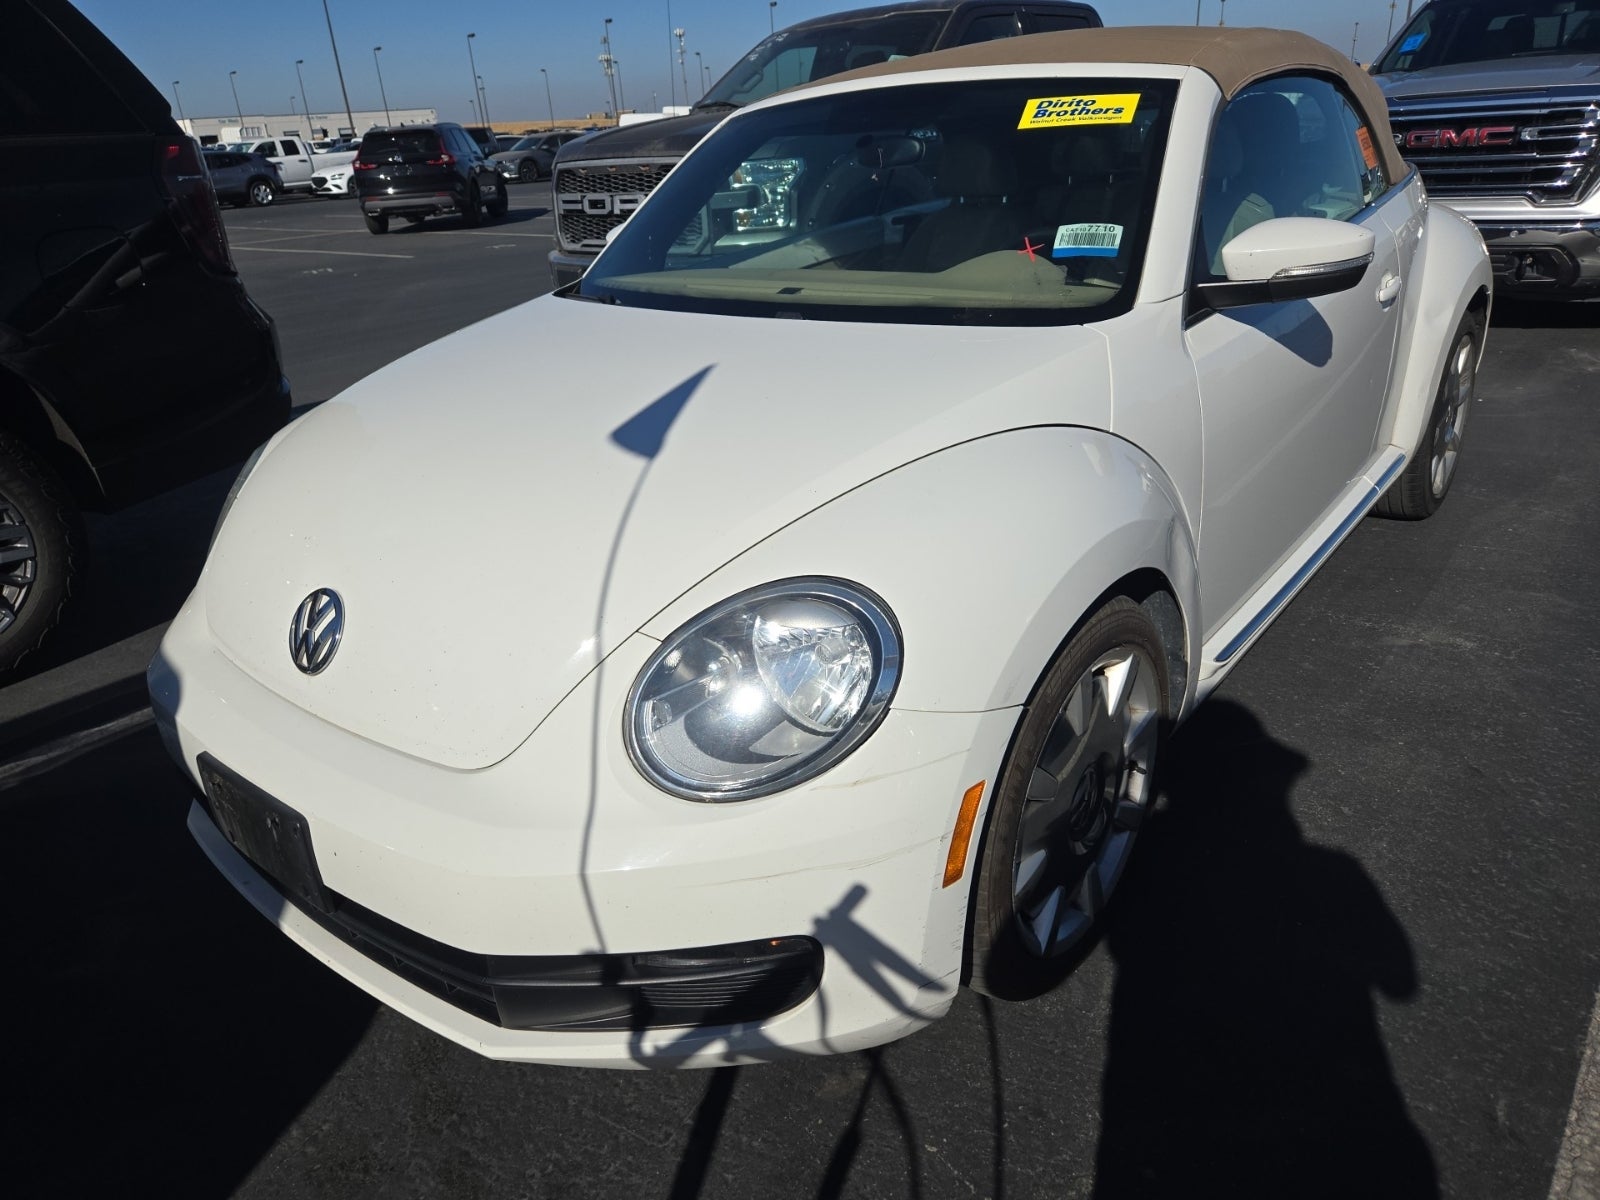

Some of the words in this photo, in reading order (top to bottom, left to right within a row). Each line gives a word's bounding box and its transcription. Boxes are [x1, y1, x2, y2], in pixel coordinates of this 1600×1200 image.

[1036, 98, 1096, 109] Dirito
[1032, 106, 1124, 119] Brothers
[1407, 126, 1515, 148] GMC
